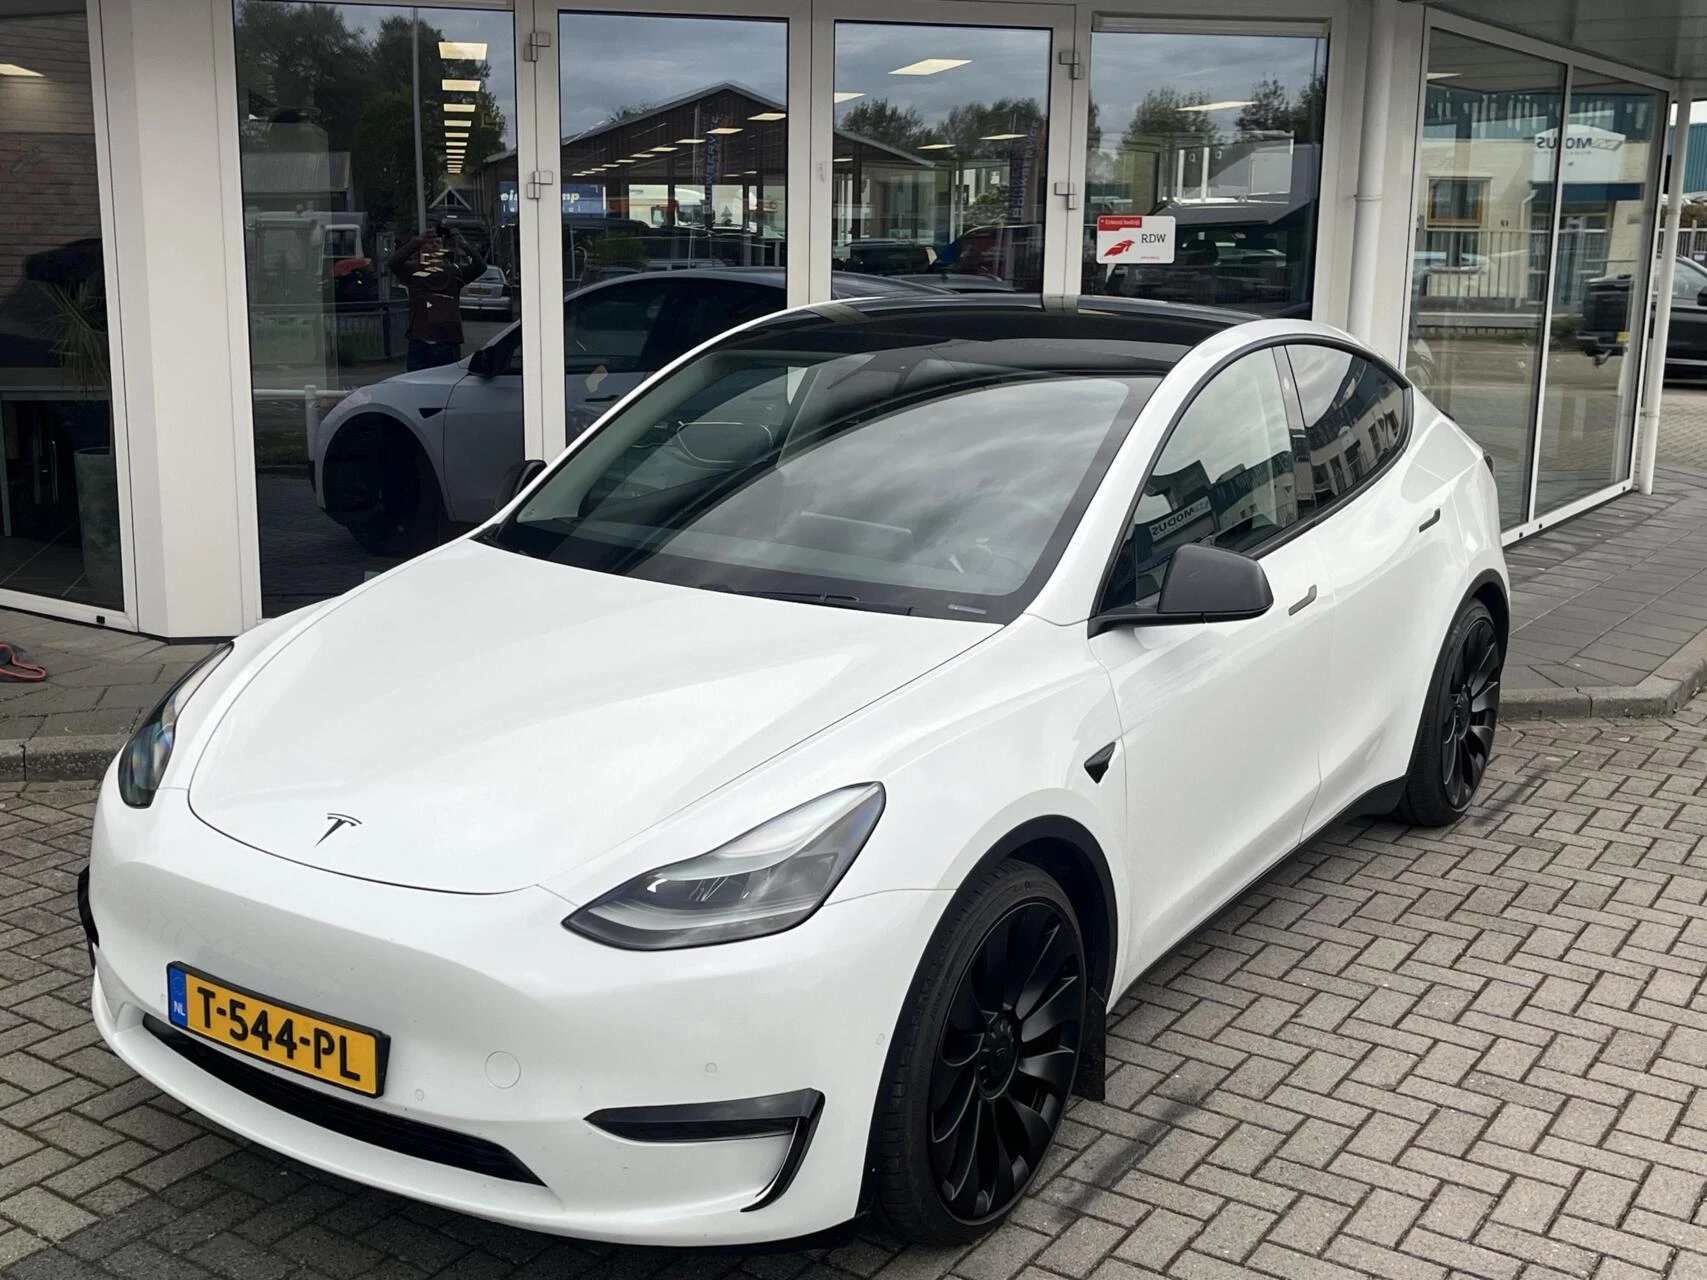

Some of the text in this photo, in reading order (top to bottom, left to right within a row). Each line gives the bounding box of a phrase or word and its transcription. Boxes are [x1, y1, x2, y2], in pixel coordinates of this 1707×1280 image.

[1141, 233, 1166, 243] RDW
[174, 1000, 186, 1017] NL
[197, 986, 361, 1082] T-544-PL
